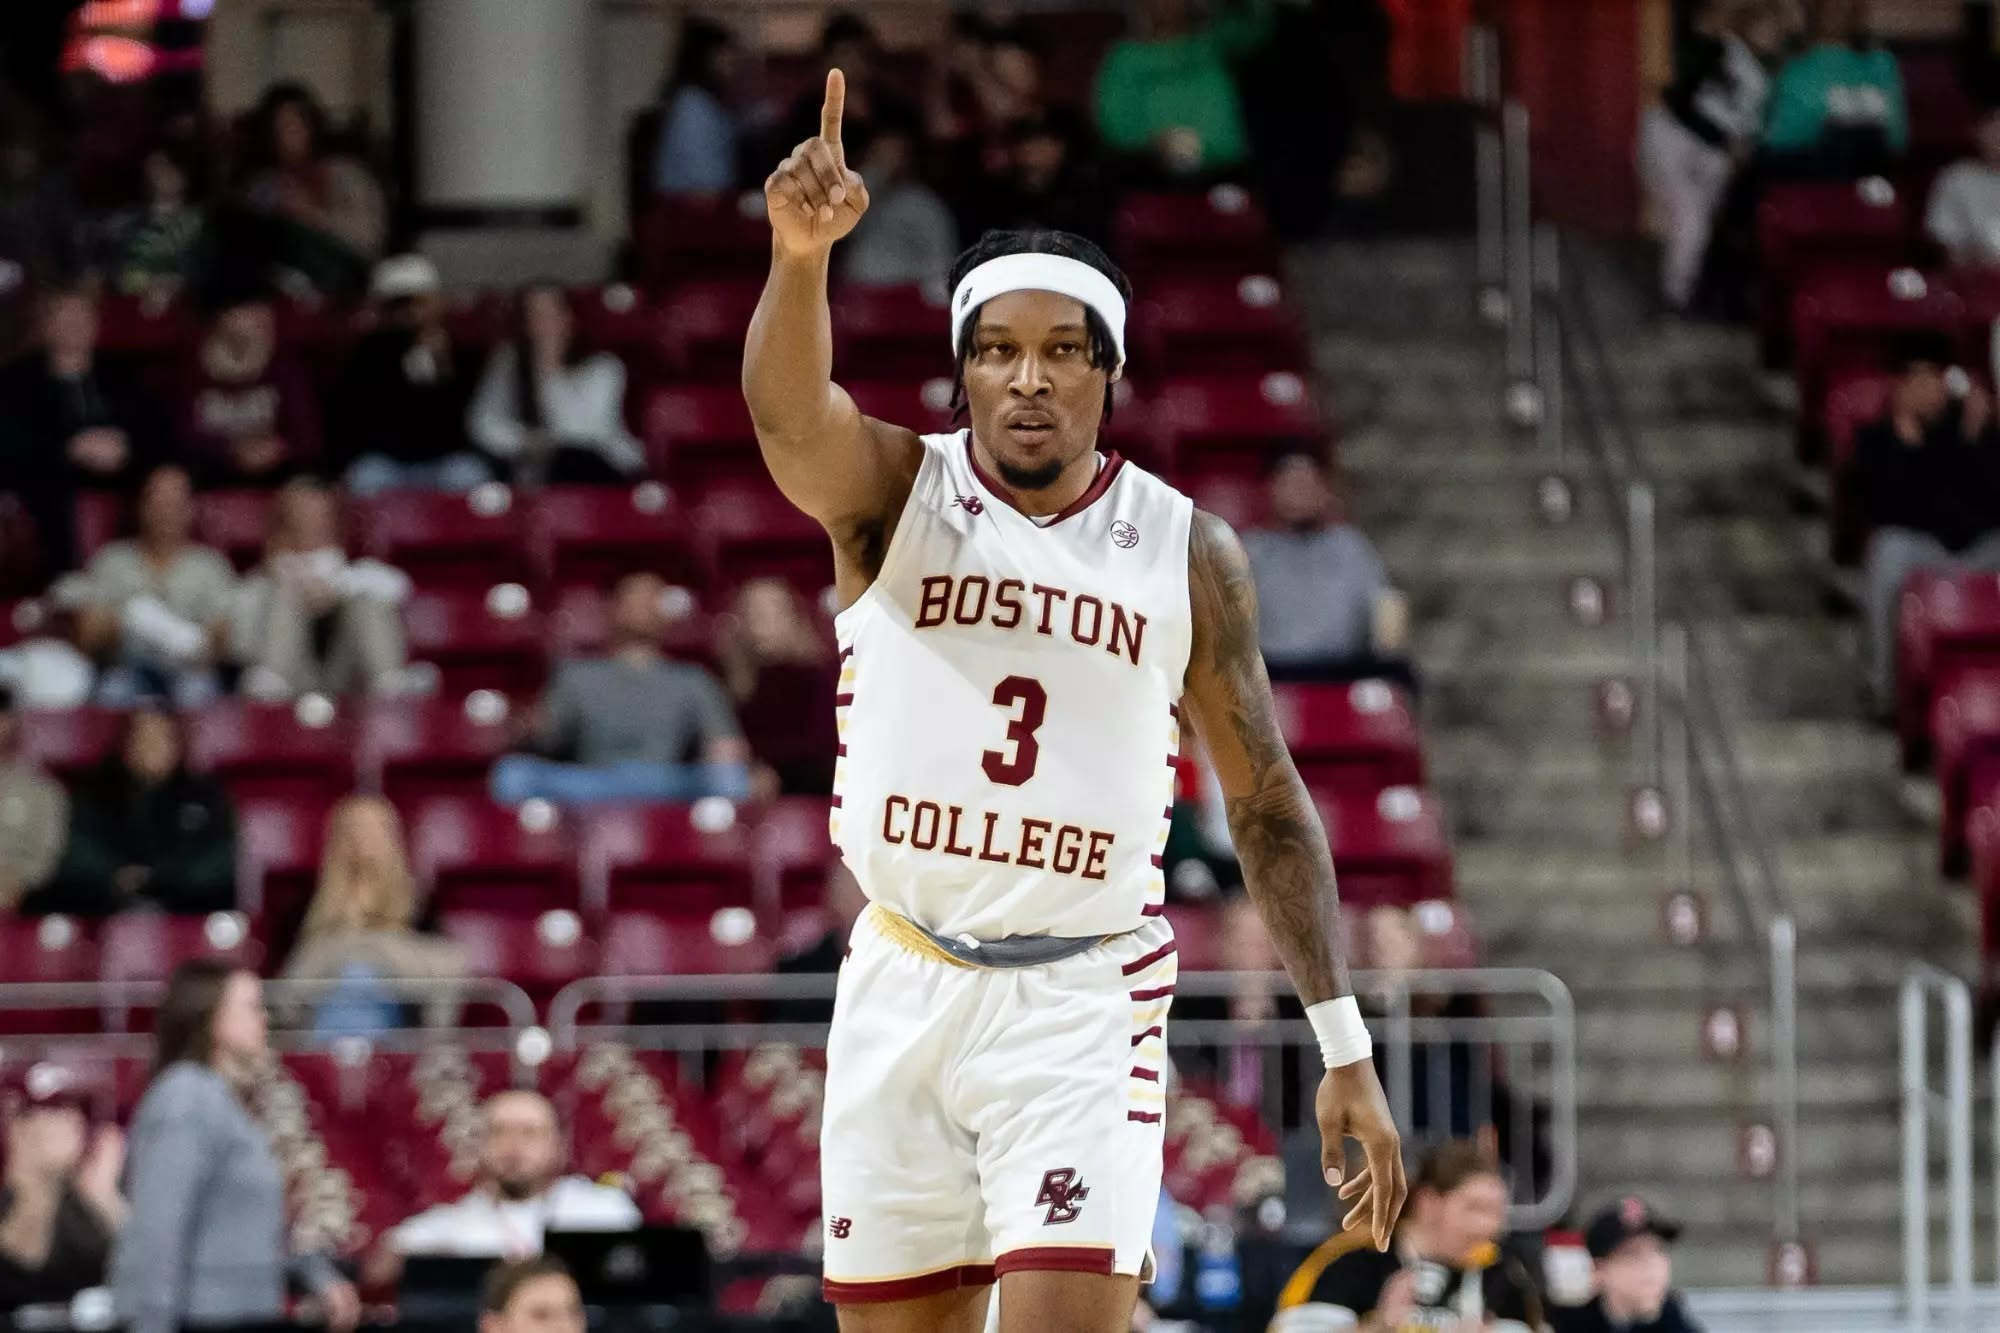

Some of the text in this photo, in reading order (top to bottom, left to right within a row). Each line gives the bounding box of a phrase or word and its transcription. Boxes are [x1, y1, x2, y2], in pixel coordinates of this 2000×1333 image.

[915, 575, 1147, 667] BOSTON
[981, 675, 1048, 787] 3
[882, 795, 1115, 880] COLLEGE
